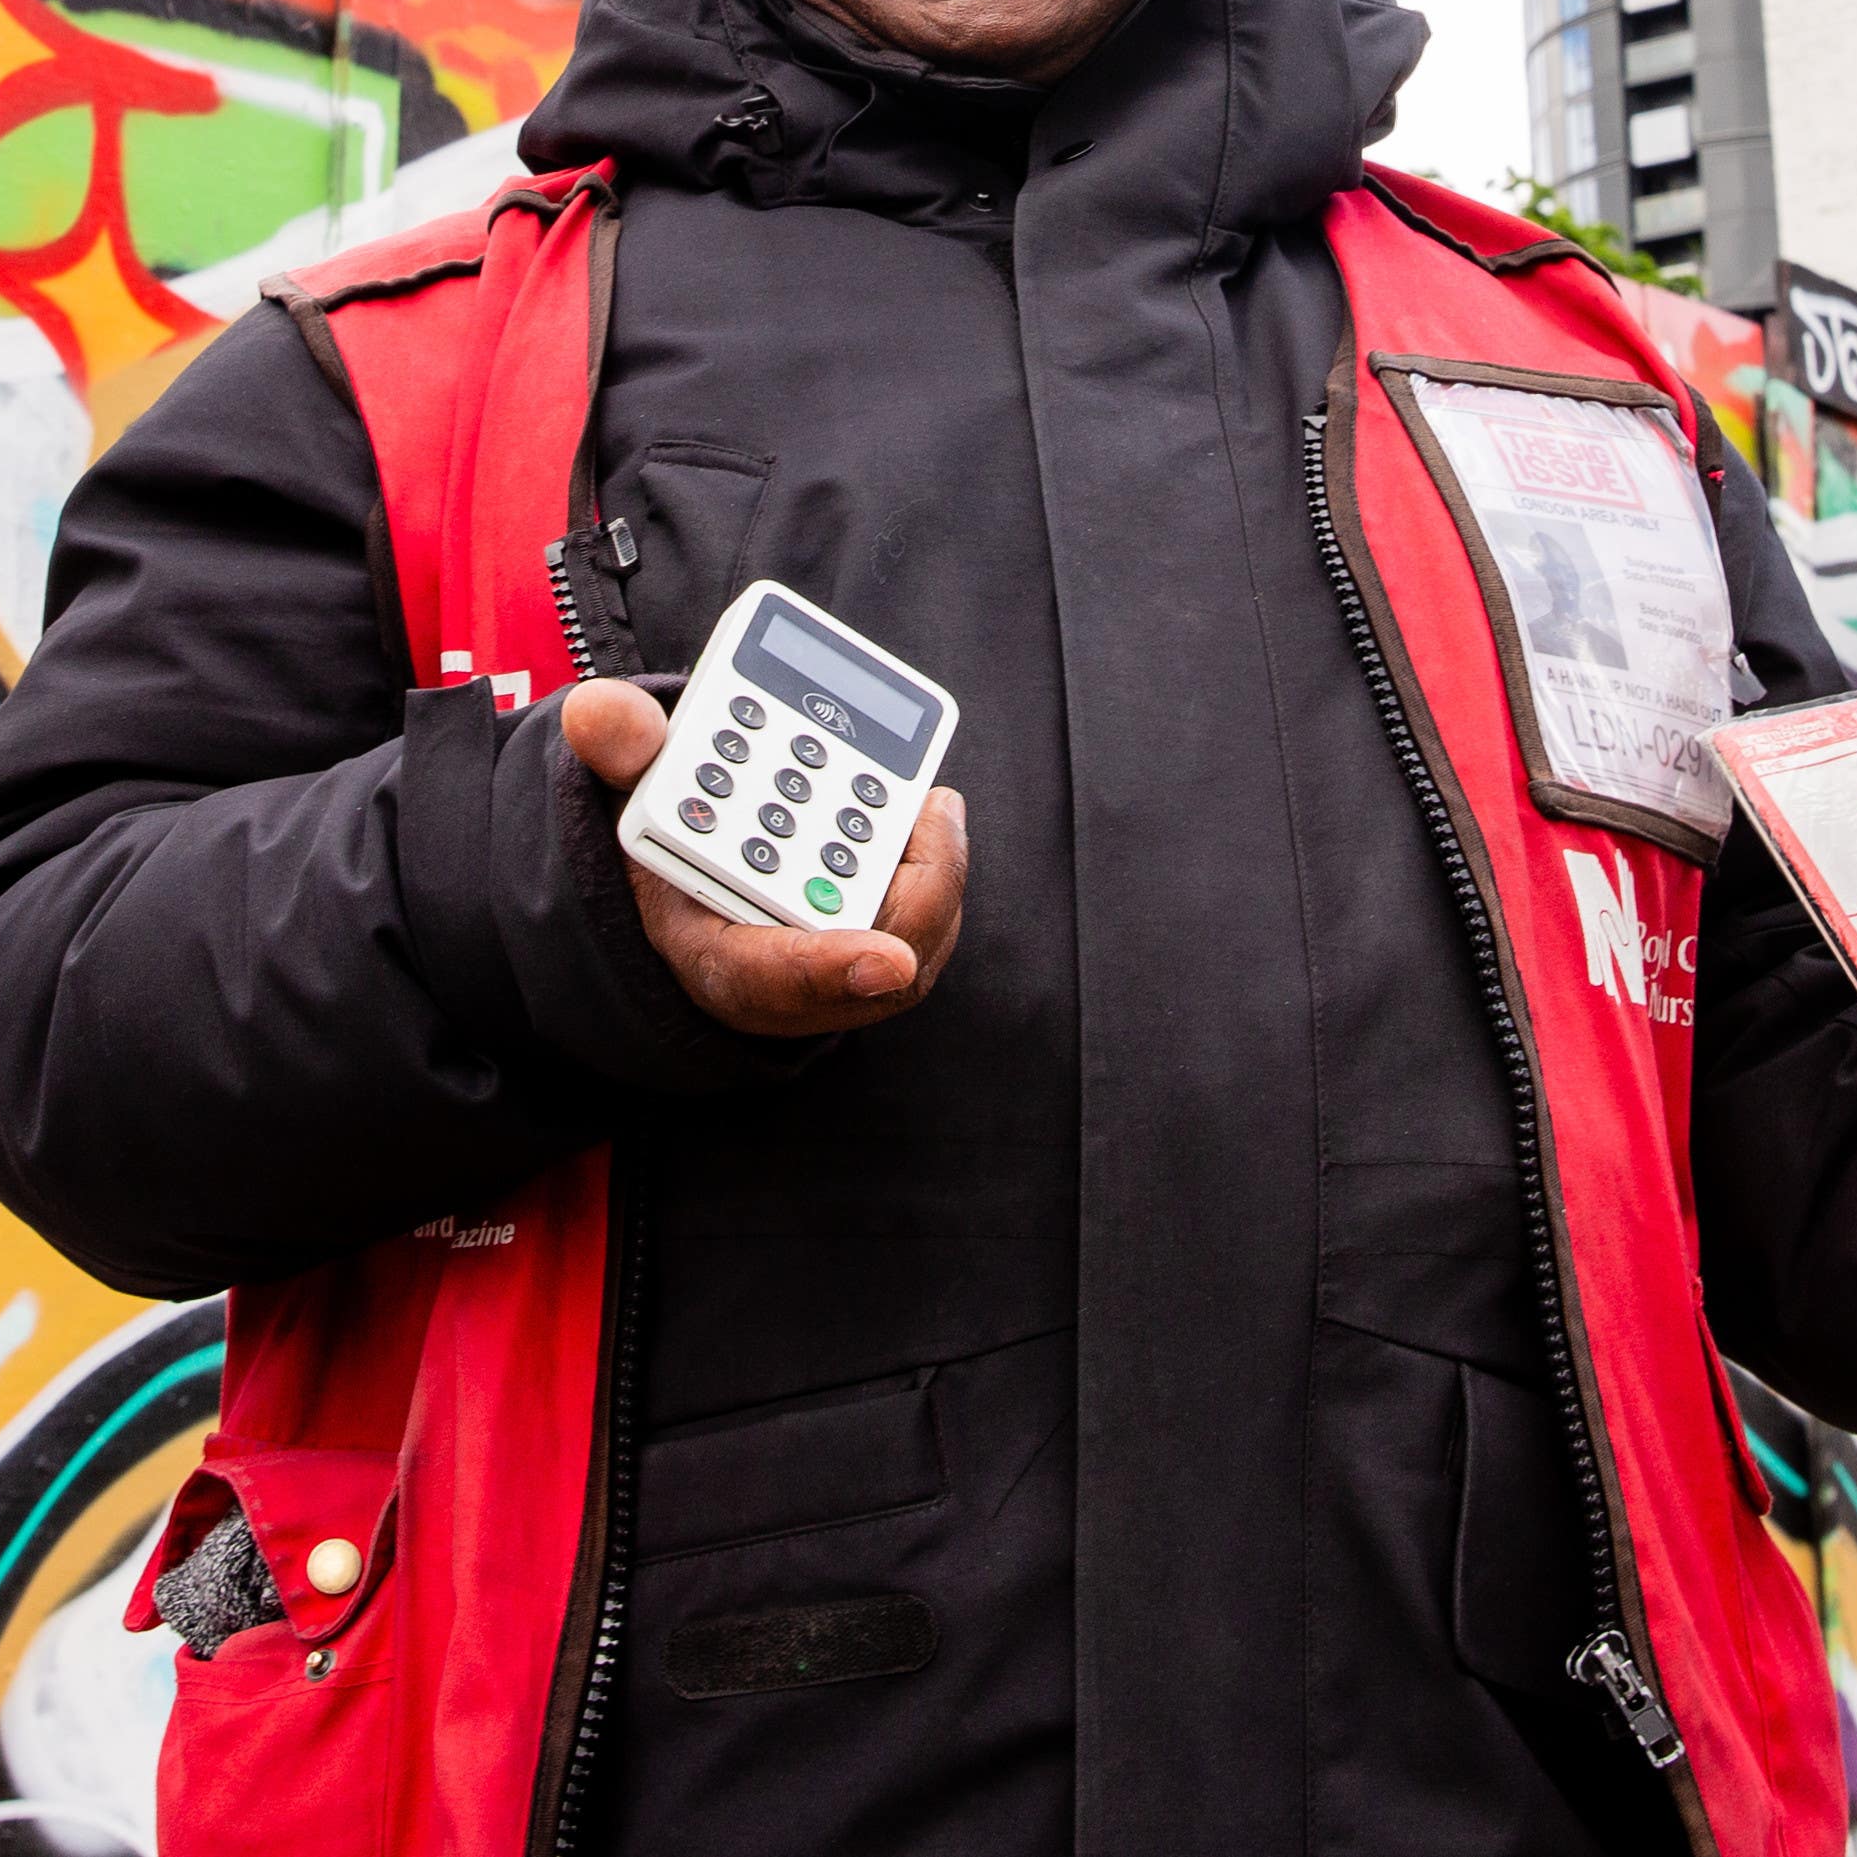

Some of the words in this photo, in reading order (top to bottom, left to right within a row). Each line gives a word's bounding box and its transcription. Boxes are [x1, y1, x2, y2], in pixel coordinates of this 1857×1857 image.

[1498, 430, 1566, 458] THE
[1564, 440, 1612, 467] BIG
[1511, 452, 1627, 497] ISSUE
[1511, 495, 1577, 518] LONDON
[1580, 505, 1620, 525] AREA
[1622, 513, 1662, 532] ONLY
[1547, 667, 1556, 683] A
[1624, 681, 1652, 702] NOT
[1655, 689, 1665, 705] A
[1665, 693, 1698, 717] HAND
[741, 703, 754, 721] 1
[801, 742, 820, 760] 2
[861, 780, 880, 799] 3
[722, 738, 740, 755] 4
[786, 775, 804, 795] 5
[846, 814, 865, 834] 6
[709, 770, 726, 787] 7
[768, 810, 787, 829] 8
[831, 848, 849, 867] 9
